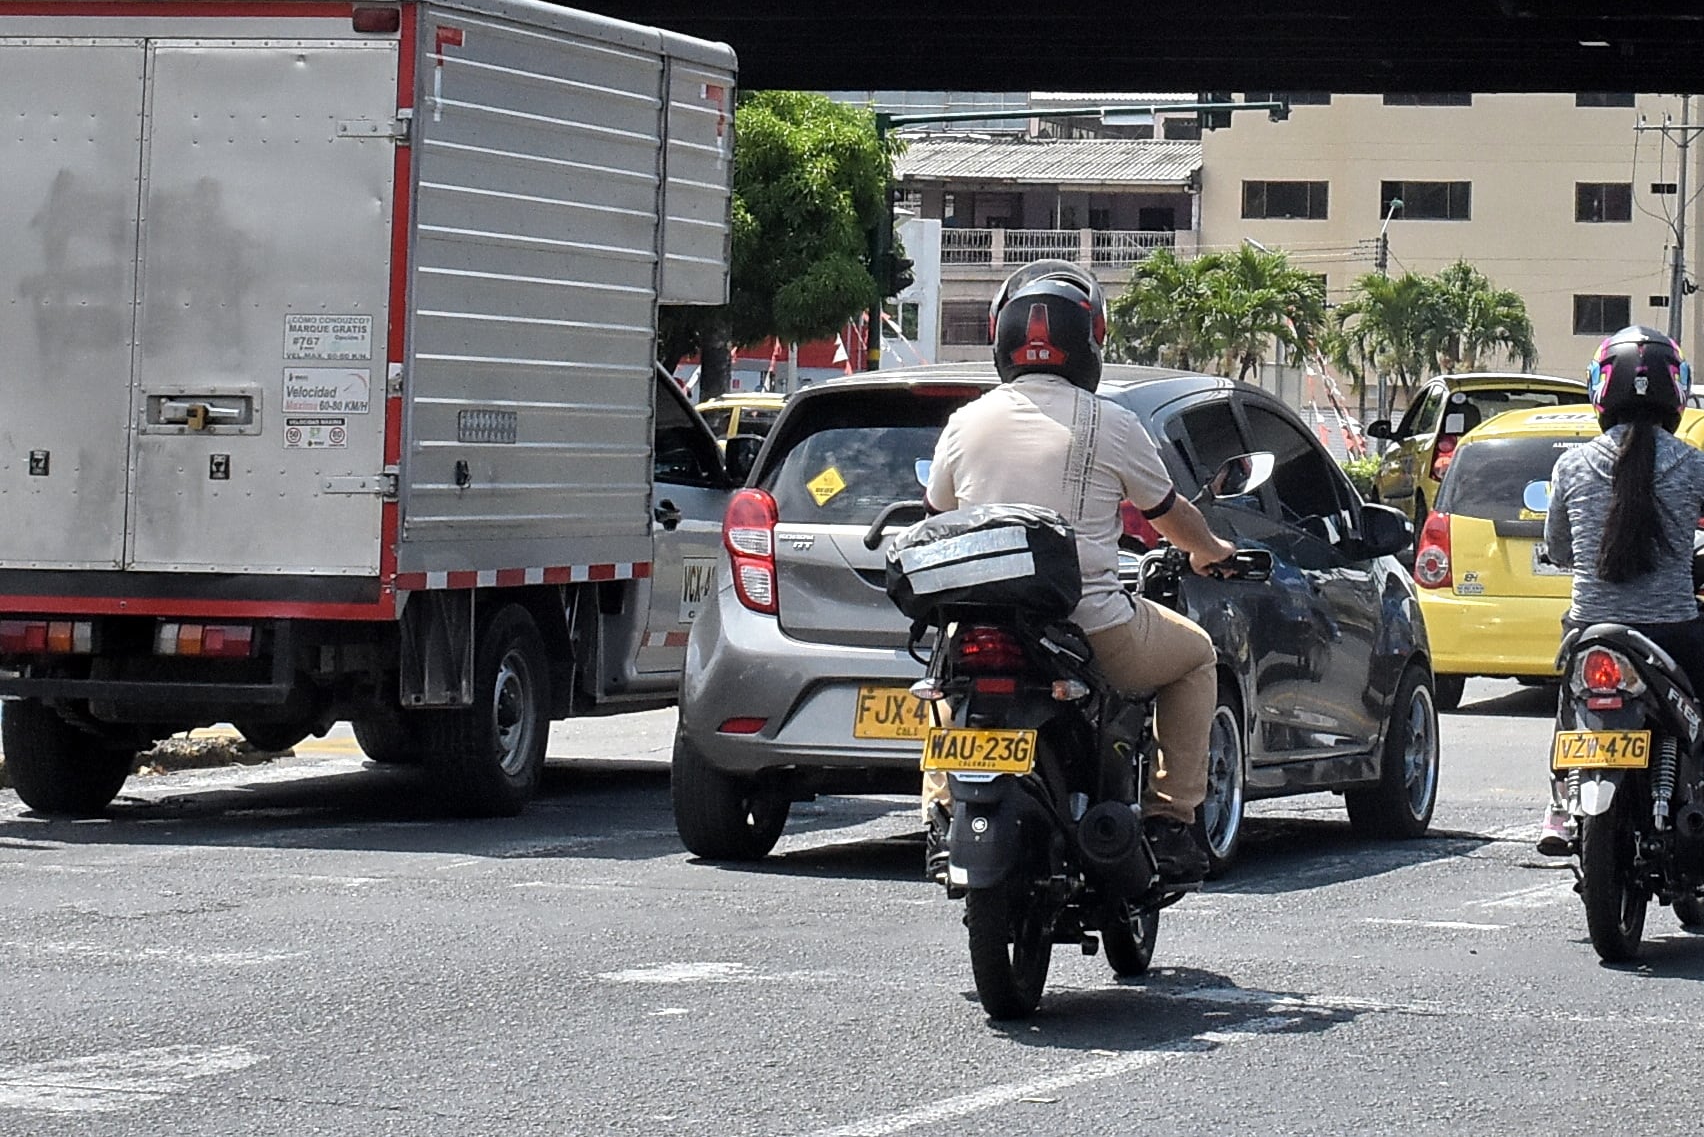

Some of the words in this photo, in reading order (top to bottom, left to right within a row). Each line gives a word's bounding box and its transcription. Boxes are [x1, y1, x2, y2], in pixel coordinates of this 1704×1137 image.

[288, 324, 329, 333] MARQUE
[332, 325, 367, 334] GRATIS
[286, 385, 338, 398] Velocidad
[344, 400, 368, 412] KM/H
[895, 726, 918, 736] CALI
